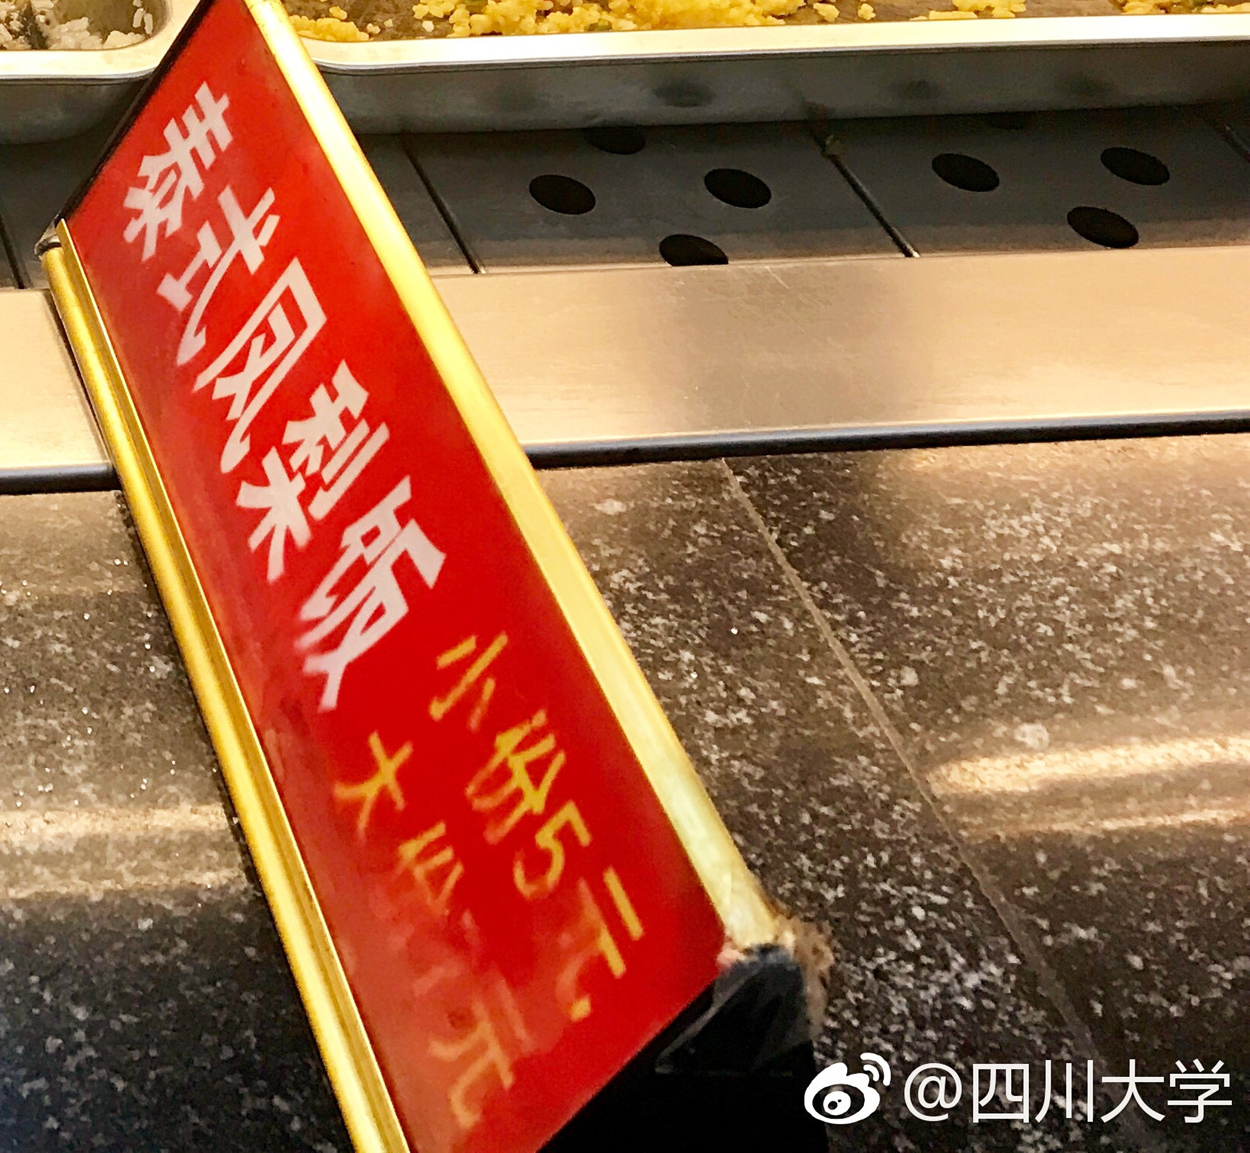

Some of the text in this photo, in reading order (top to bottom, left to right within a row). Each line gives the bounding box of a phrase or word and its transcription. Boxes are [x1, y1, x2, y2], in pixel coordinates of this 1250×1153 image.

[122, 82, 444, 710] 泰式凤梨饭
[432, 633, 643, 1021] 小份5元
